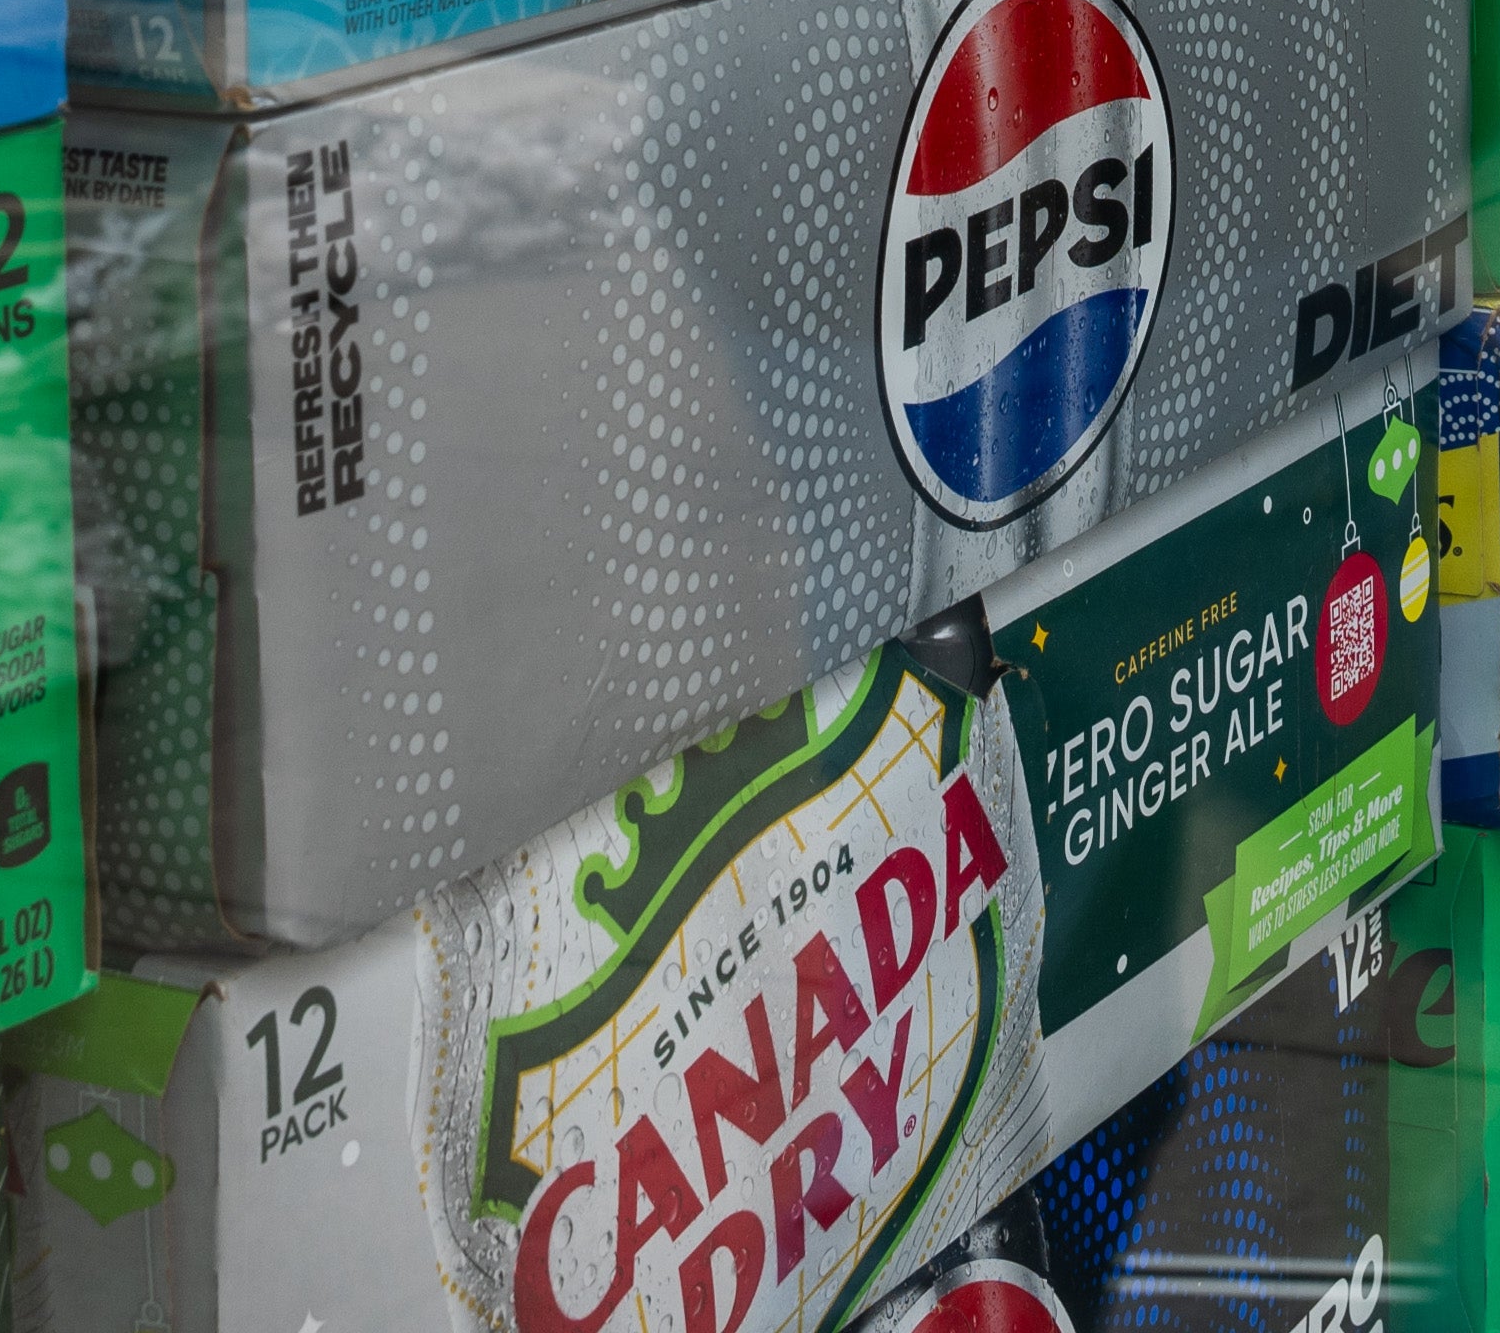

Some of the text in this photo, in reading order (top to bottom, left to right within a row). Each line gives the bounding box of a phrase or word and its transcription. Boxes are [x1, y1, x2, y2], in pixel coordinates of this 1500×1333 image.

[286, 149, 328, 518] REFRESH THEN
[321, 140, 366, 506] RECYCLE
[903, 142, 1153, 351] PEPSI
[1289, 213, 1468, 396] DIET
[0, 647, 45, 693] SODA
[1047, 595, 1308, 815] ERO SUGAR
[1115, 592, 1238, 684] CAFFEINE FREE
[1065, 680, 1282, 865] GINGER ALE
[1250, 785, 1403, 916] Recipes, Tips & More
[247, 986, 345, 1121] 12
[515, 771, 1007, 1333] CANADA
[653, 843, 855, 1067] SINCE 1904
[259, 1095, 349, 1163] PACK
[679, 1007, 912, 1333] DRY
